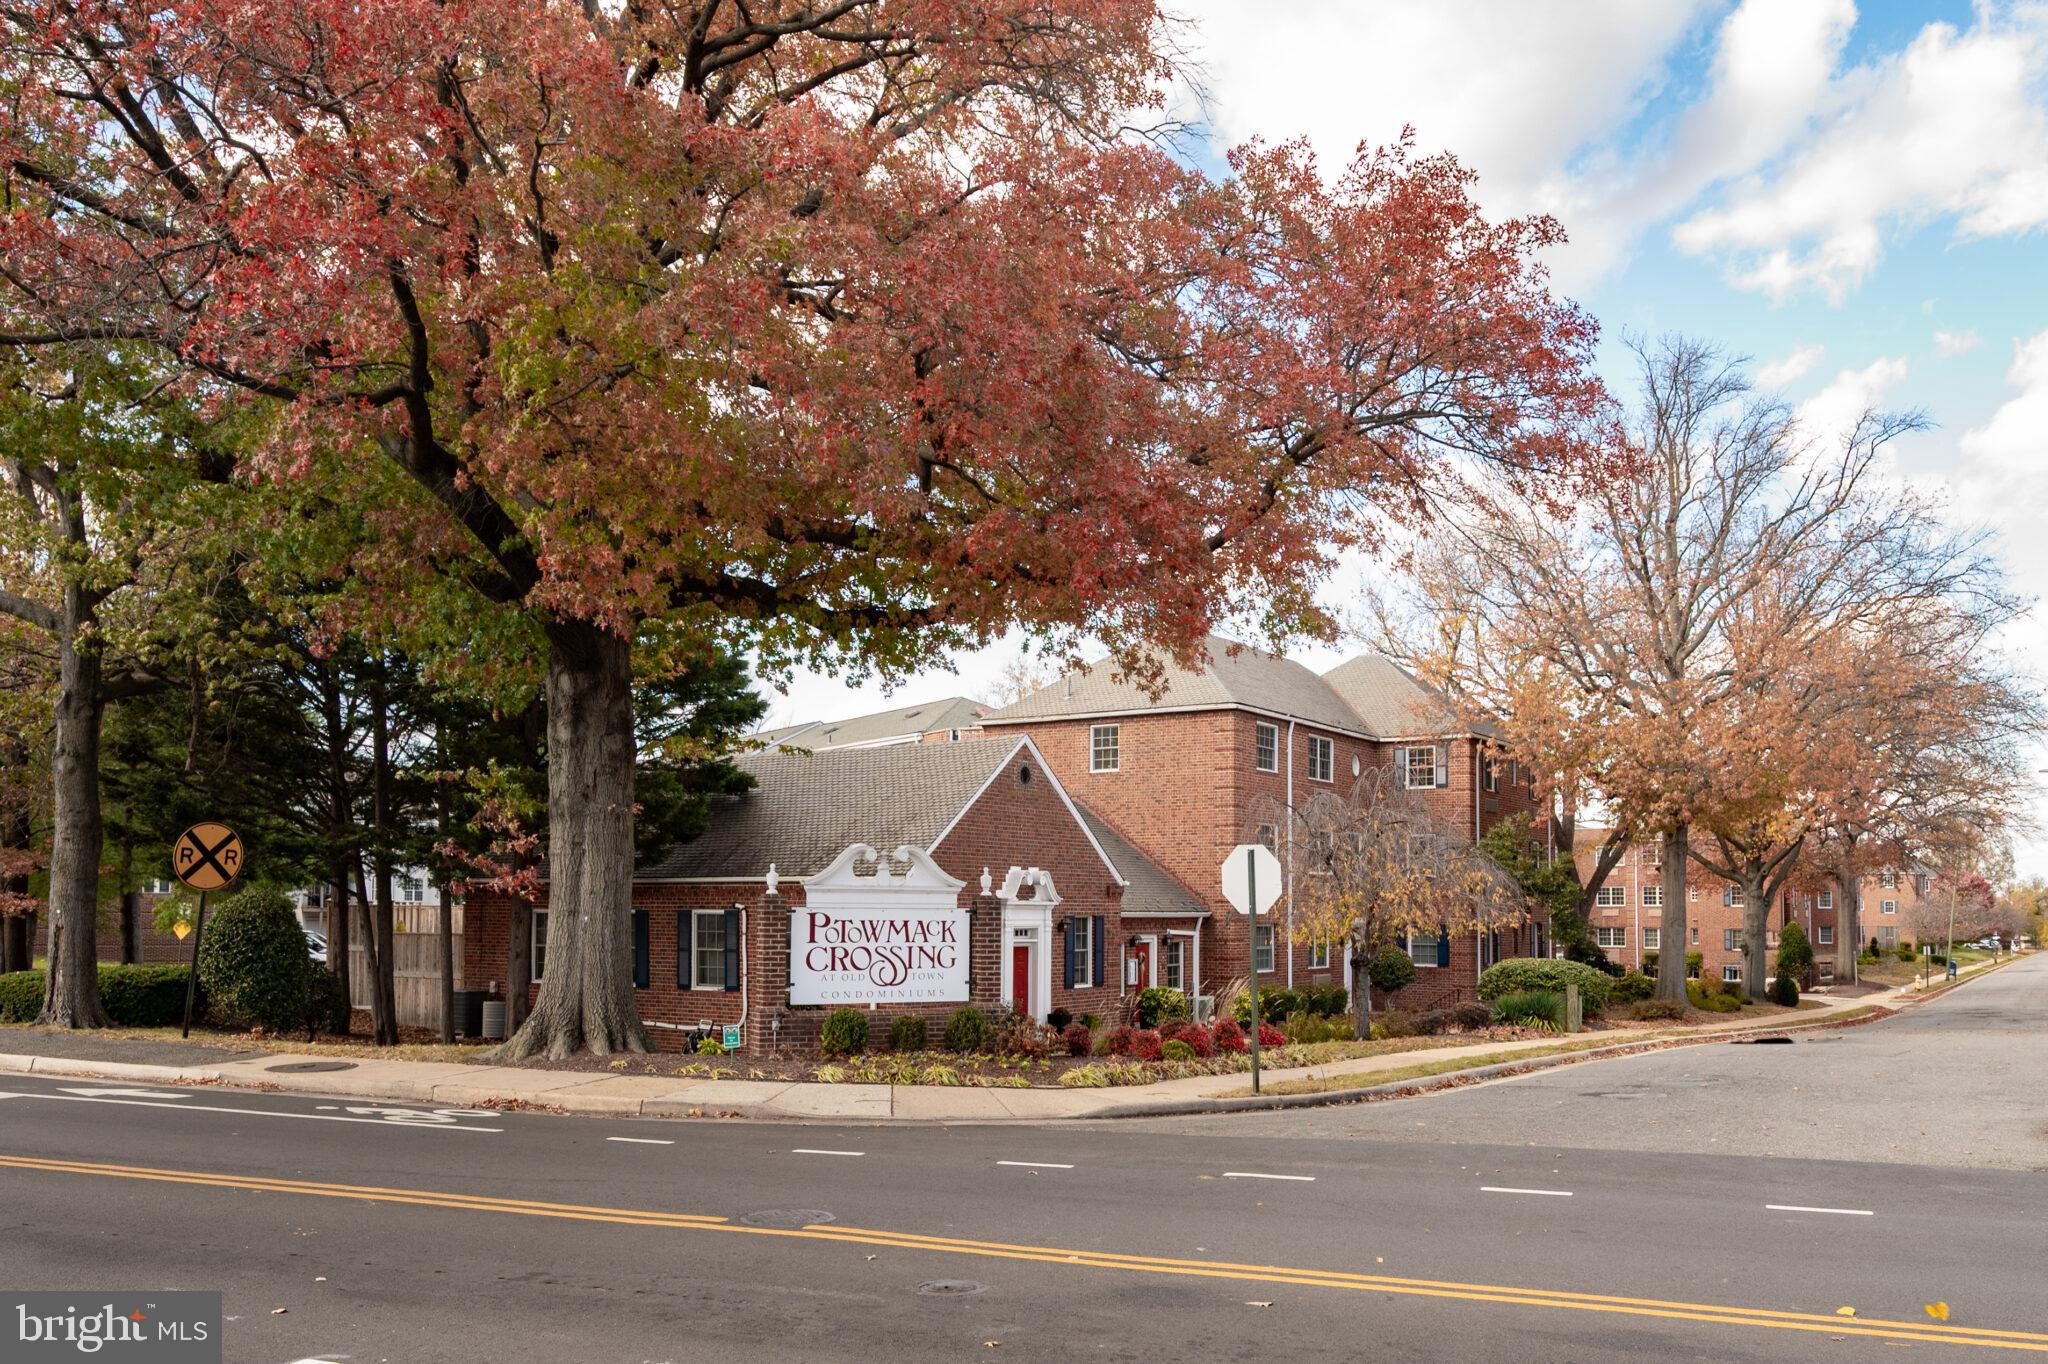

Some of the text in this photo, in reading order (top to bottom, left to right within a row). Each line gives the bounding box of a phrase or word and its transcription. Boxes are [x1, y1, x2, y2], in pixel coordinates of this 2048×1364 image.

[180, 847, 193, 864] R
[224, 849, 238, 865] R
[806, 912, 957, 944] POTOWMACK
[805, 945, 957, 986] CROSSING
[821, 972, 945, 982] AT OLD TOWN
[820, 989, 945, 999] CONDOMINIUMS
